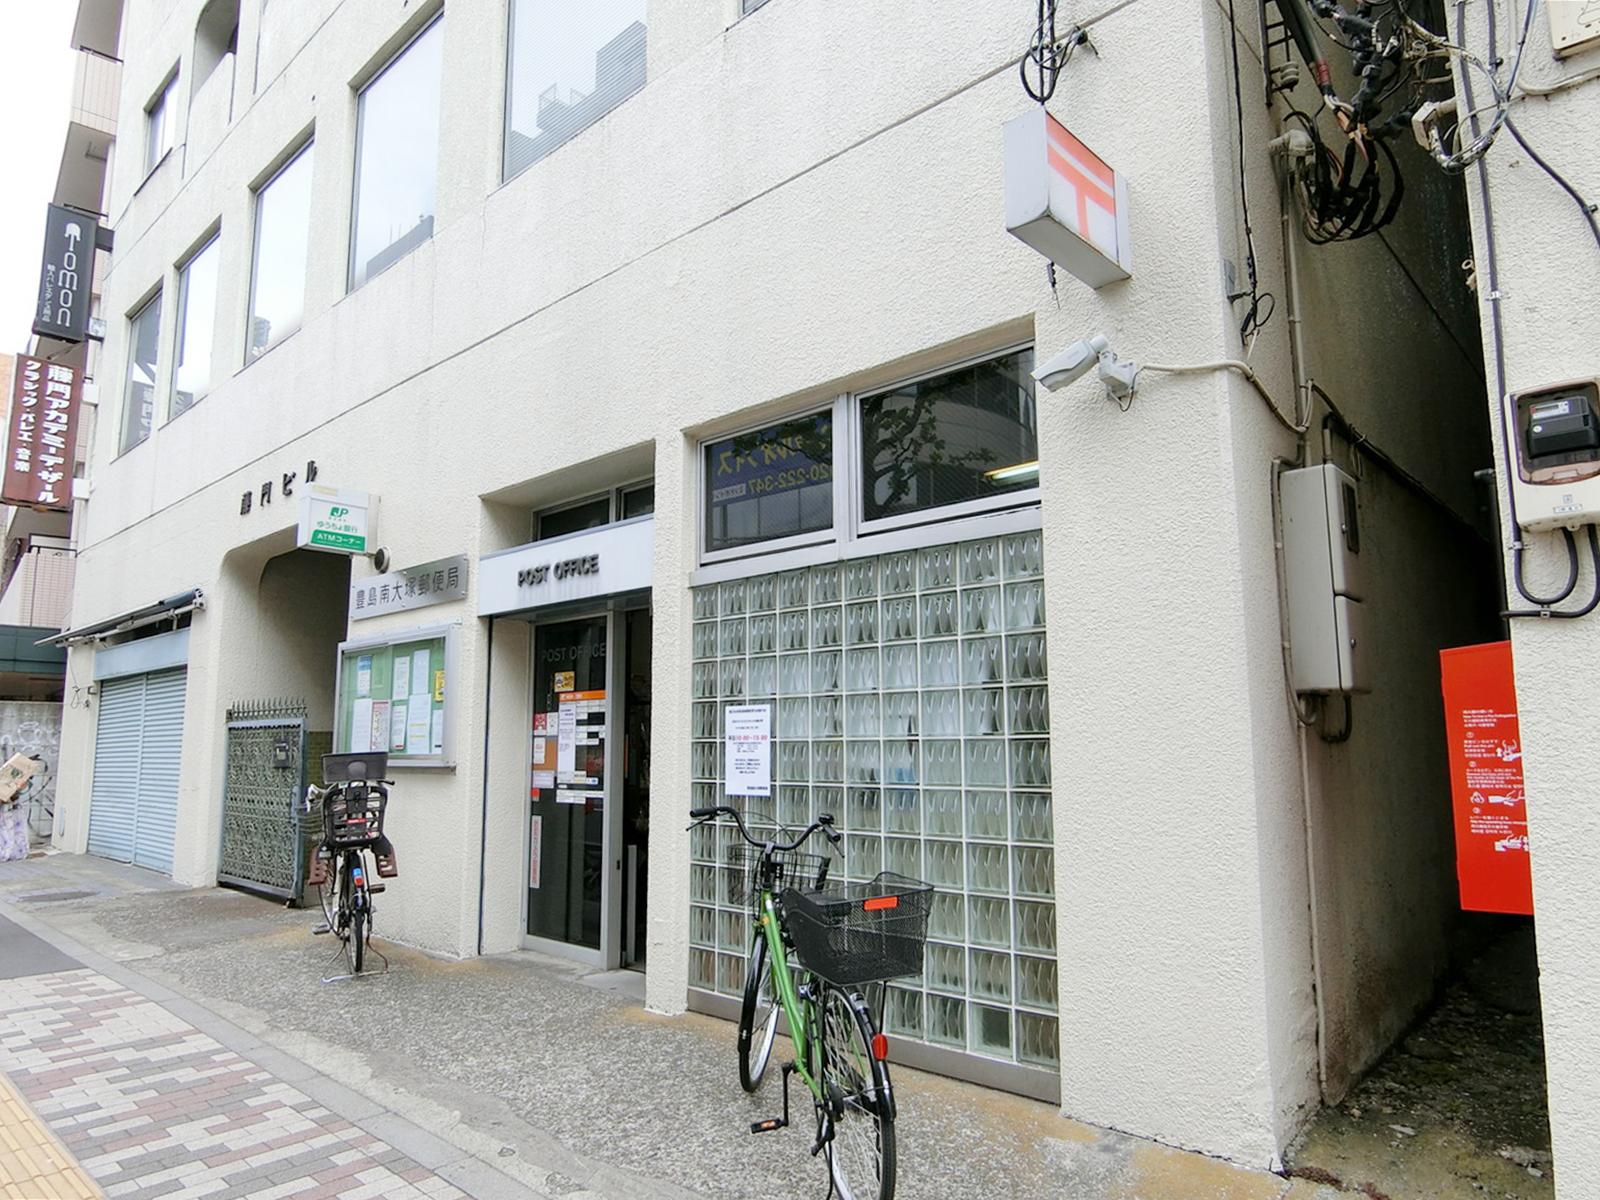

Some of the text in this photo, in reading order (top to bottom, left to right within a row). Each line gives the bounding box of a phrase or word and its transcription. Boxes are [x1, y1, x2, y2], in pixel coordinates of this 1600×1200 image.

[317, 520, 358, 534] ゆうちょ銀行
[316, 533, 362, 545] ATMコーナー
[518, 553, 600, 587] POST OFFICE
[355, 566, 459, 610] 豊島南大塚郵便局
[541, 642, 606, 662] POST OFFICE
